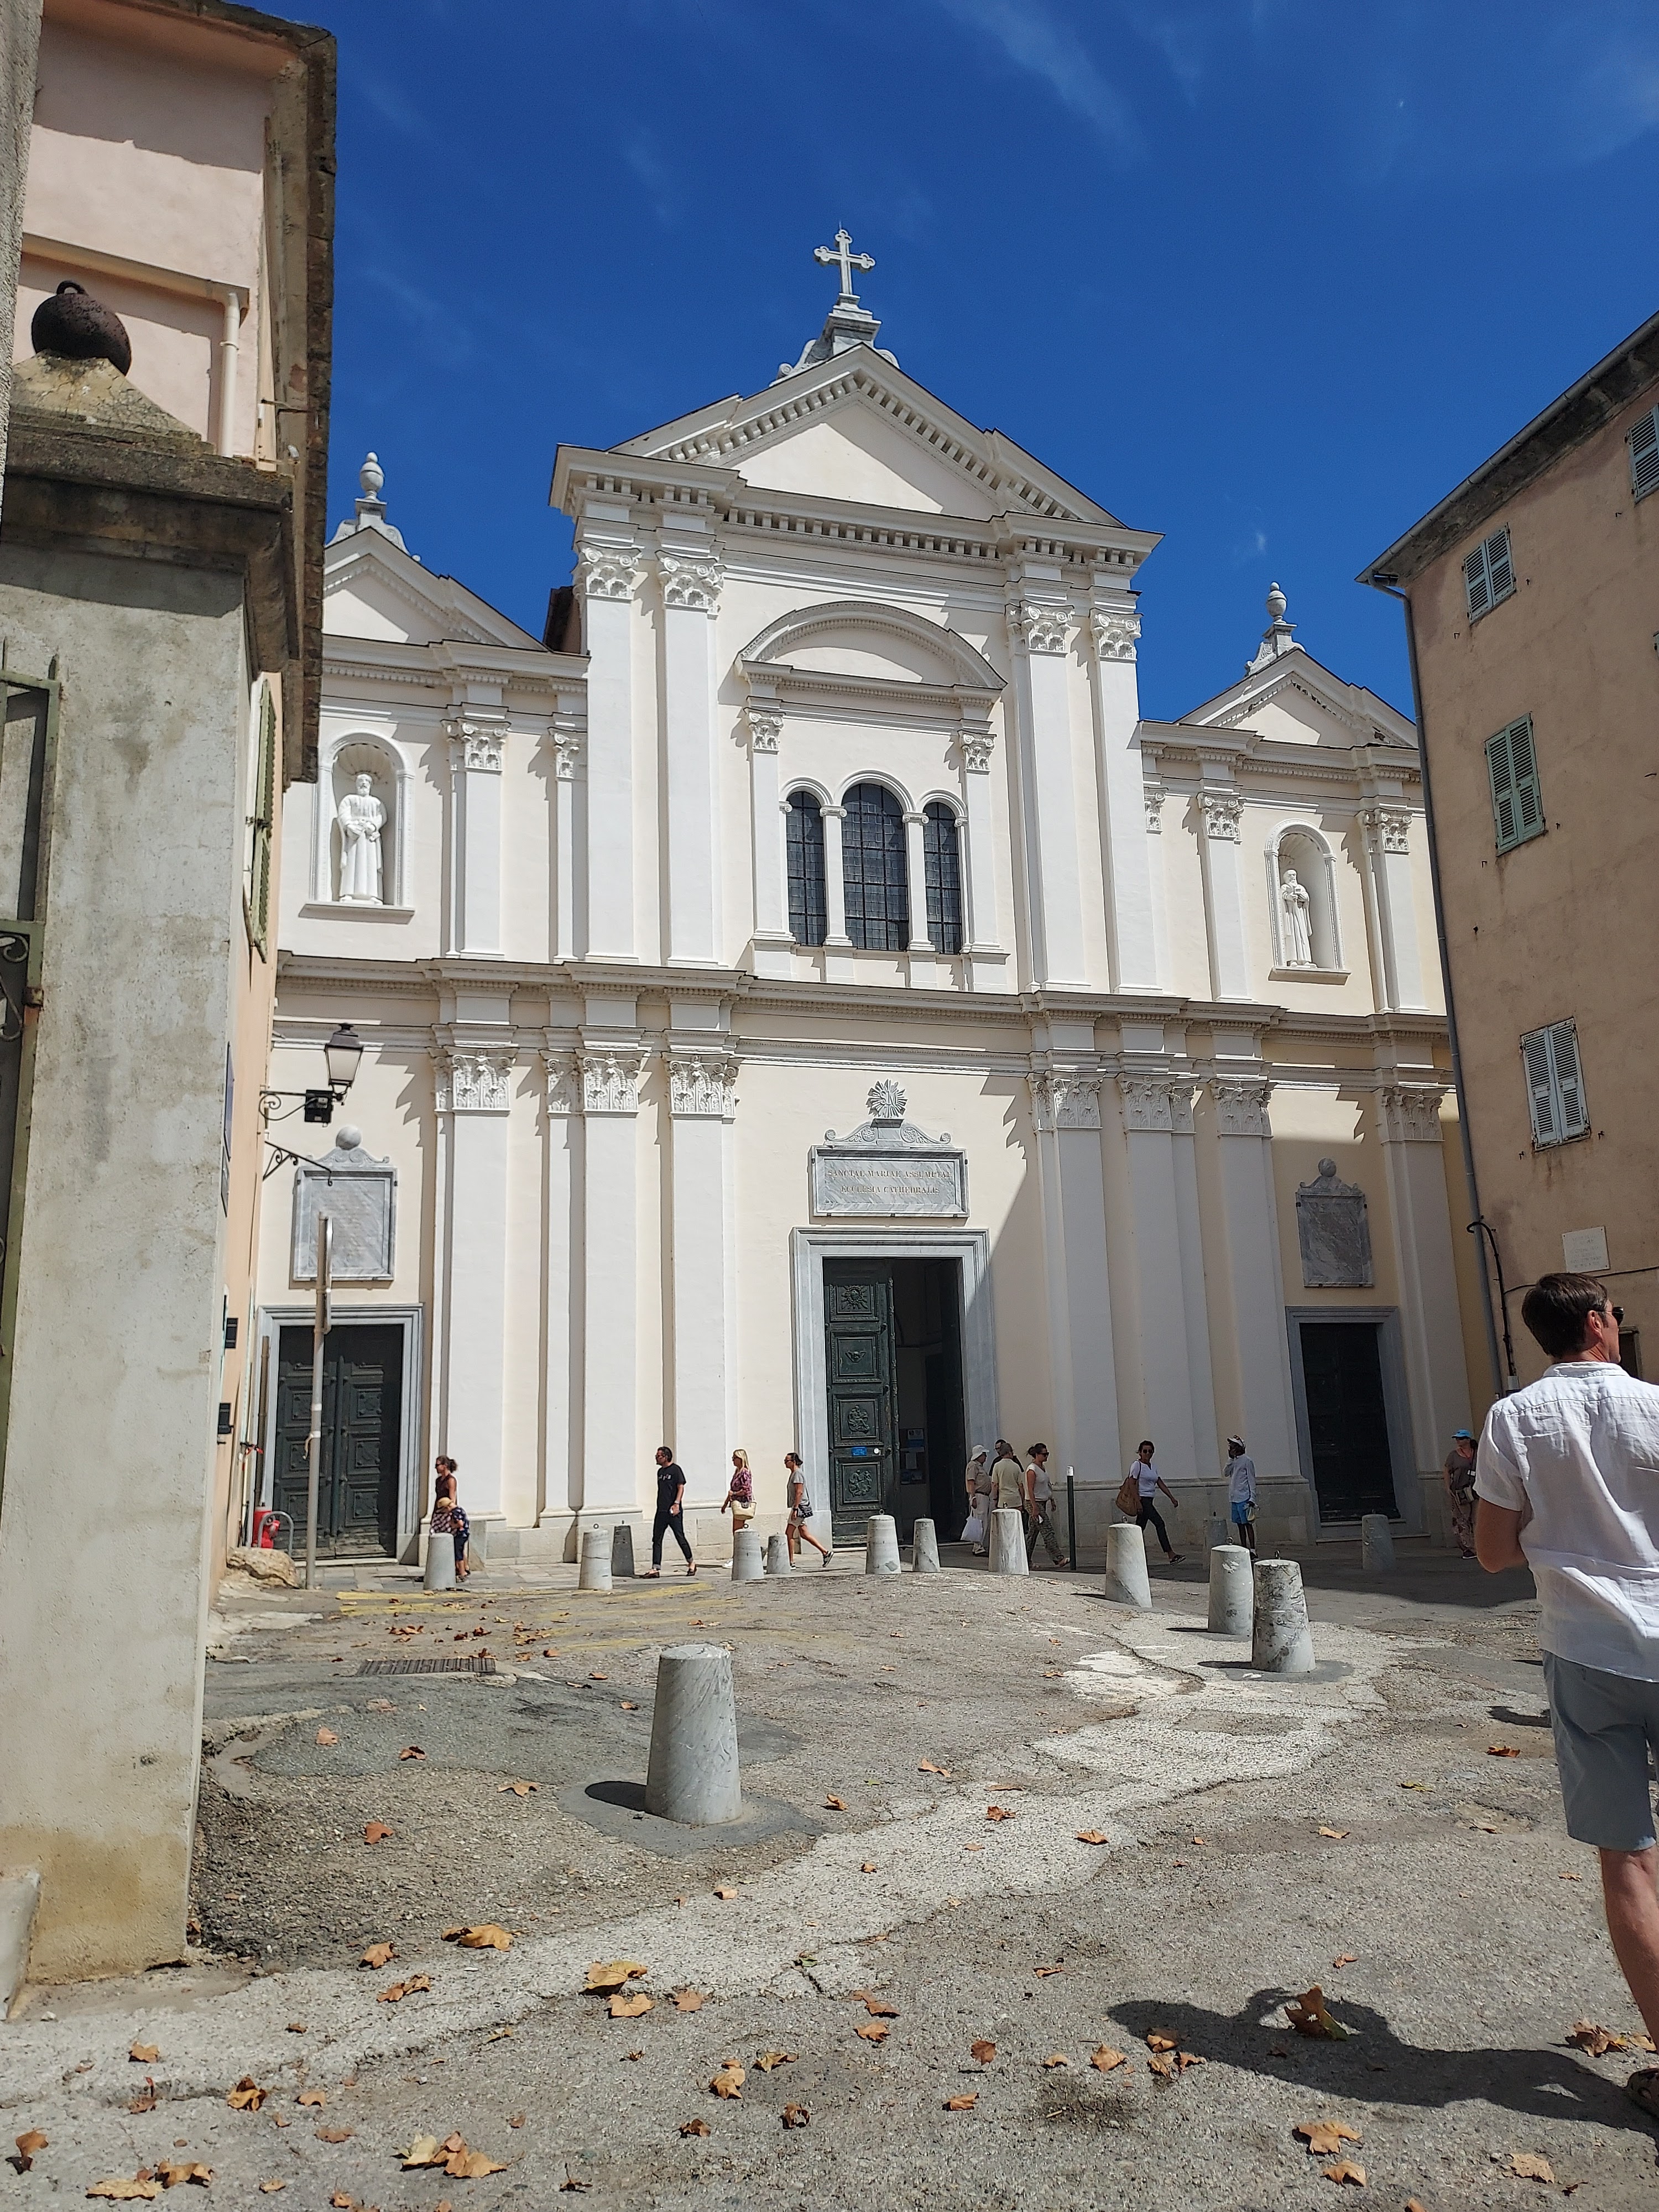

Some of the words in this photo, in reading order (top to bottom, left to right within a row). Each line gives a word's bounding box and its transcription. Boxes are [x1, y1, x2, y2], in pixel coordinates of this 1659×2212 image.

[904, 1171, 952, 1179] ASSUMPTAE
[841, 1185, 880, 1193] ECCLESIA
[884, 1186, 940, 1194] CATHEDRALIS
